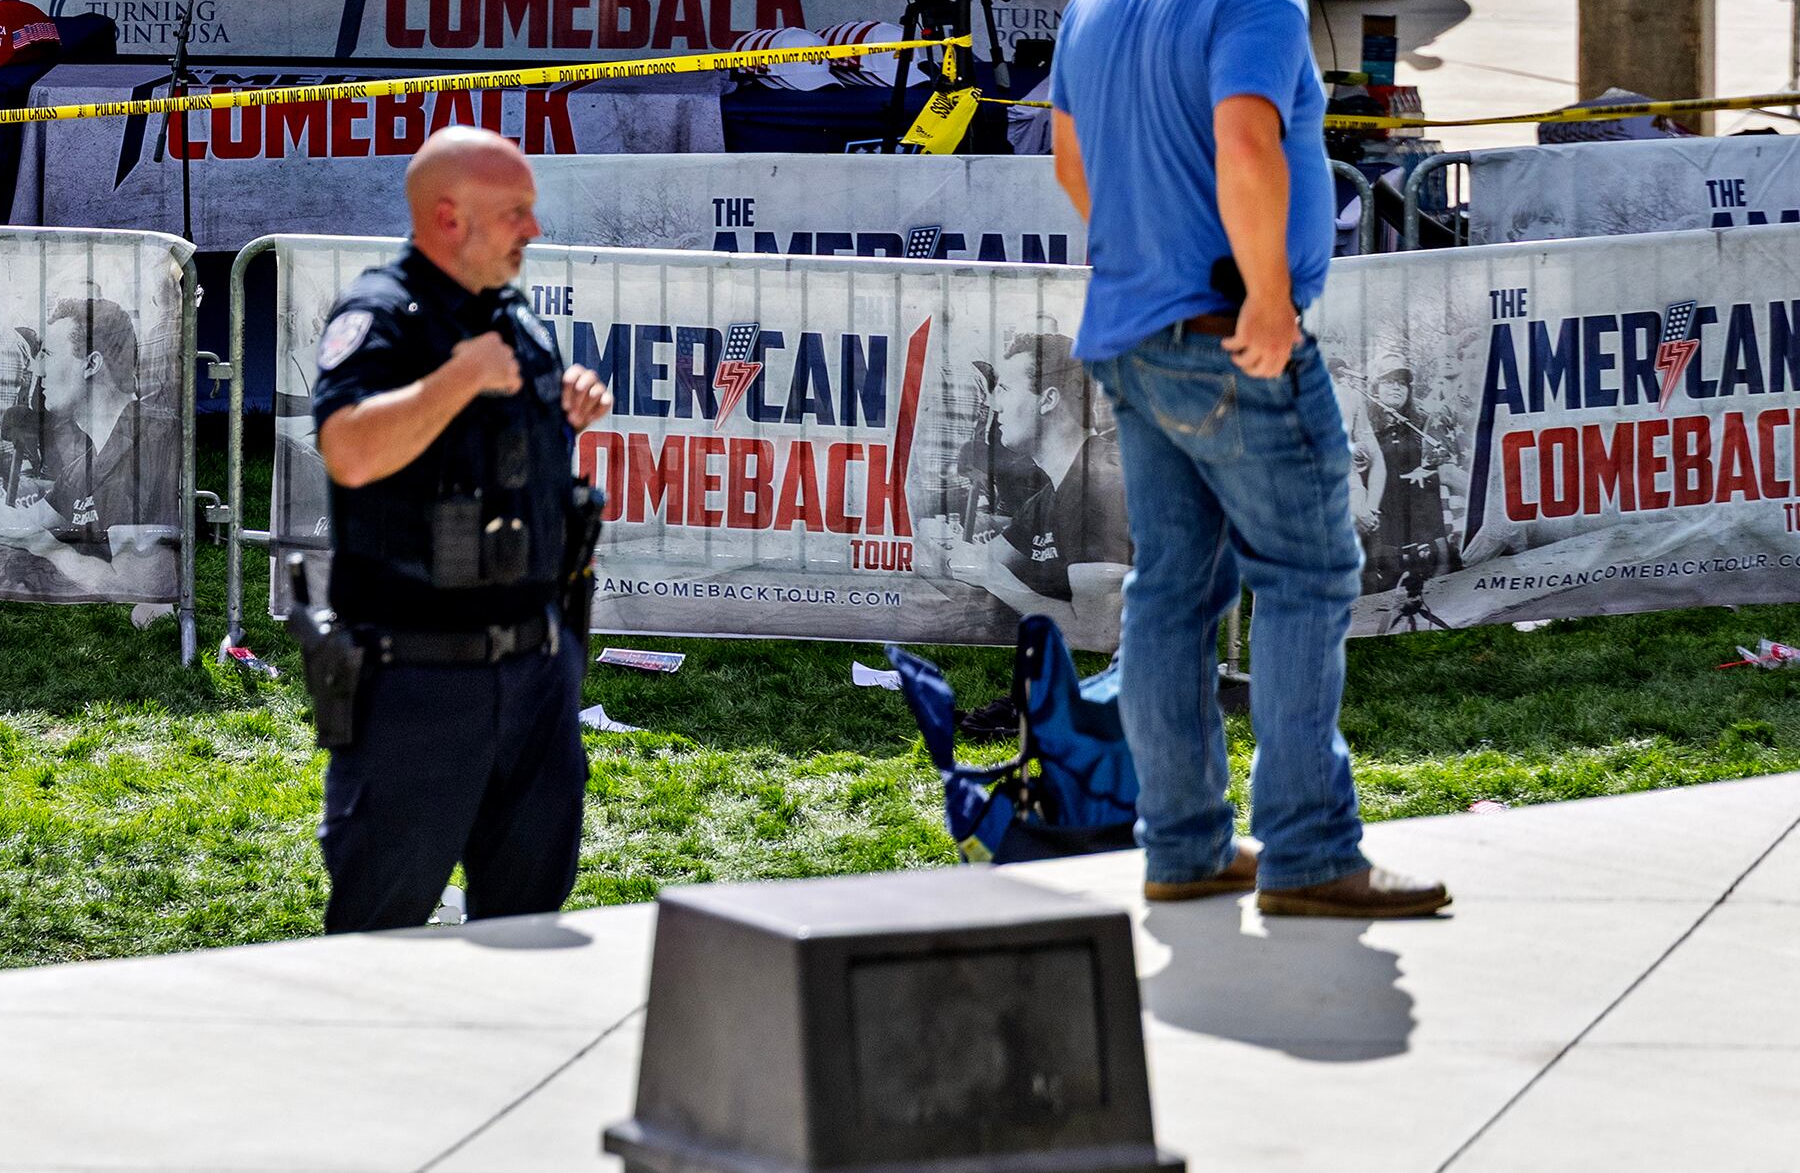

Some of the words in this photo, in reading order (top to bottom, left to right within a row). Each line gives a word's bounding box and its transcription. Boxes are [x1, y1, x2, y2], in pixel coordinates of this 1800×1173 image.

[85, 0, 215, 22] TURNING
[186, 23, 231, 43] USA
[405, 80, 436, 93] POLICE
[437, 79, 458, 92] LINE
[459, 78, 471, 90] DO
[473, 77, 492, 88] NOT
[493, 74, 522, 87] CROSS
[560, 69, 591, 82] POLICE
[592, 68, 613, 80] LINE
[615, 67, 627, 78] DO
[629, 65, 647, 77] NOT
[648, 62, 678, 74] CROSS
[95, 102, 126, 116] POLICE
[128, 100, 148, 115] LINE
[150, 99, 162, 113] DO
[164, 98, 183, 112] NOT
[183, 95, 213, 110] CROSS
[250, 91, 281, 105] POLICE
[283, 90, 303, 104] LINE
[305, 89, 317, 102] DO
[319, 88, 338, 101] NOT
[338, 85, 368, 98] CROSS
[9, 109, 28, 121] NOT
[28, 107, 58, 120] CROSS
[1706, 179, 1747, 208] THE
[712, 198, 755, 226] THE
[532, 285, 573, 316] THE
[1489, 288, 1528, 319] THE
[541, 322, 888, 430] MERICAN
[578, 314, 931, 537] OMEBACK
[1502, 408, 1800, 522] COMEBAC
[850, 540, 913, 572] TOUR
